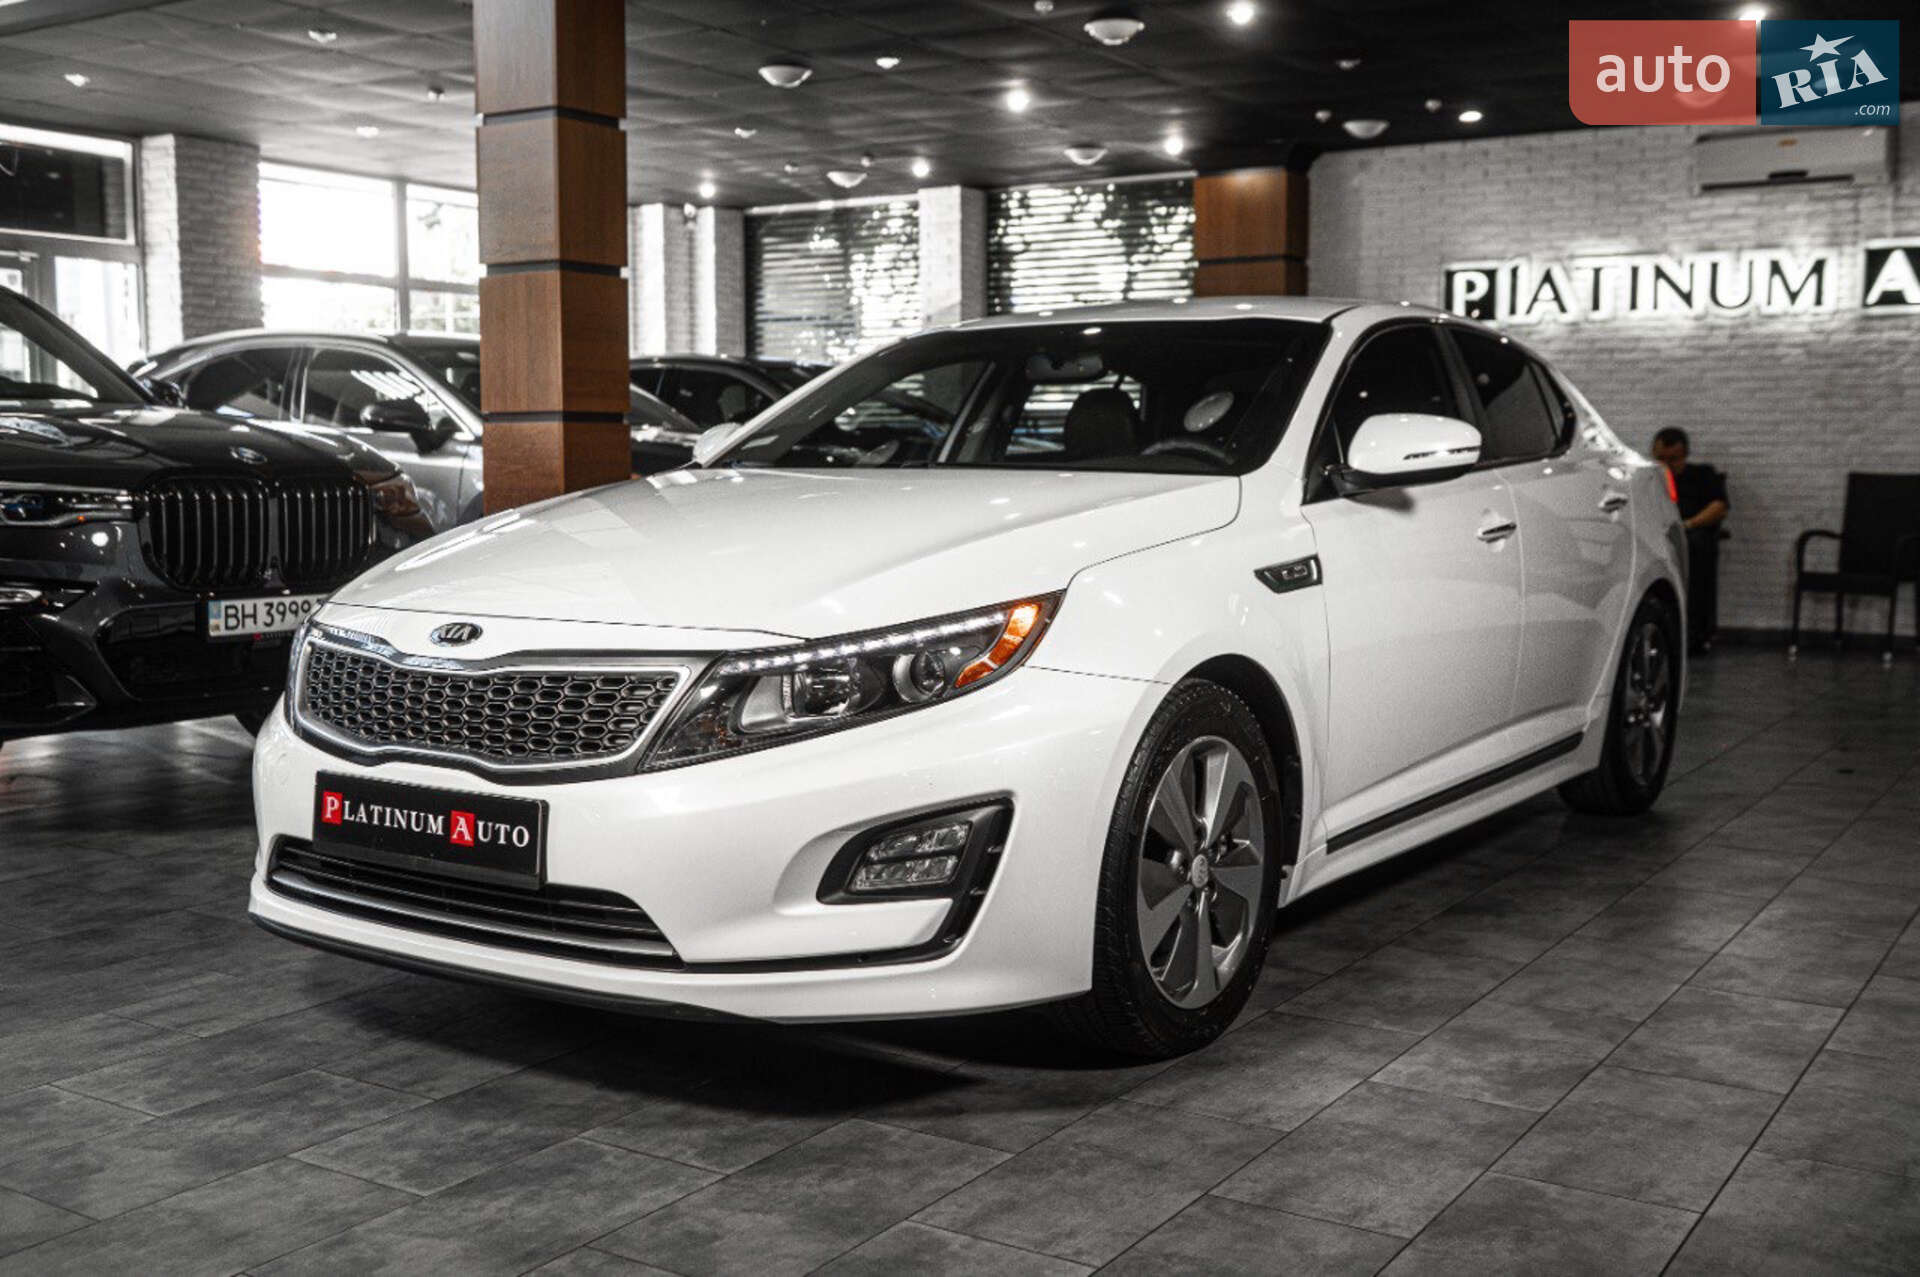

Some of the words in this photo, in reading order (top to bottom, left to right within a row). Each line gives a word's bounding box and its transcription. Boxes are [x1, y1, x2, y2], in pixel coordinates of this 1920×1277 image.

[224, 602, 258, 631] BH
[325, 795, 446, 836] PLATINUM
[452, 815, 530, 848] AUTO
